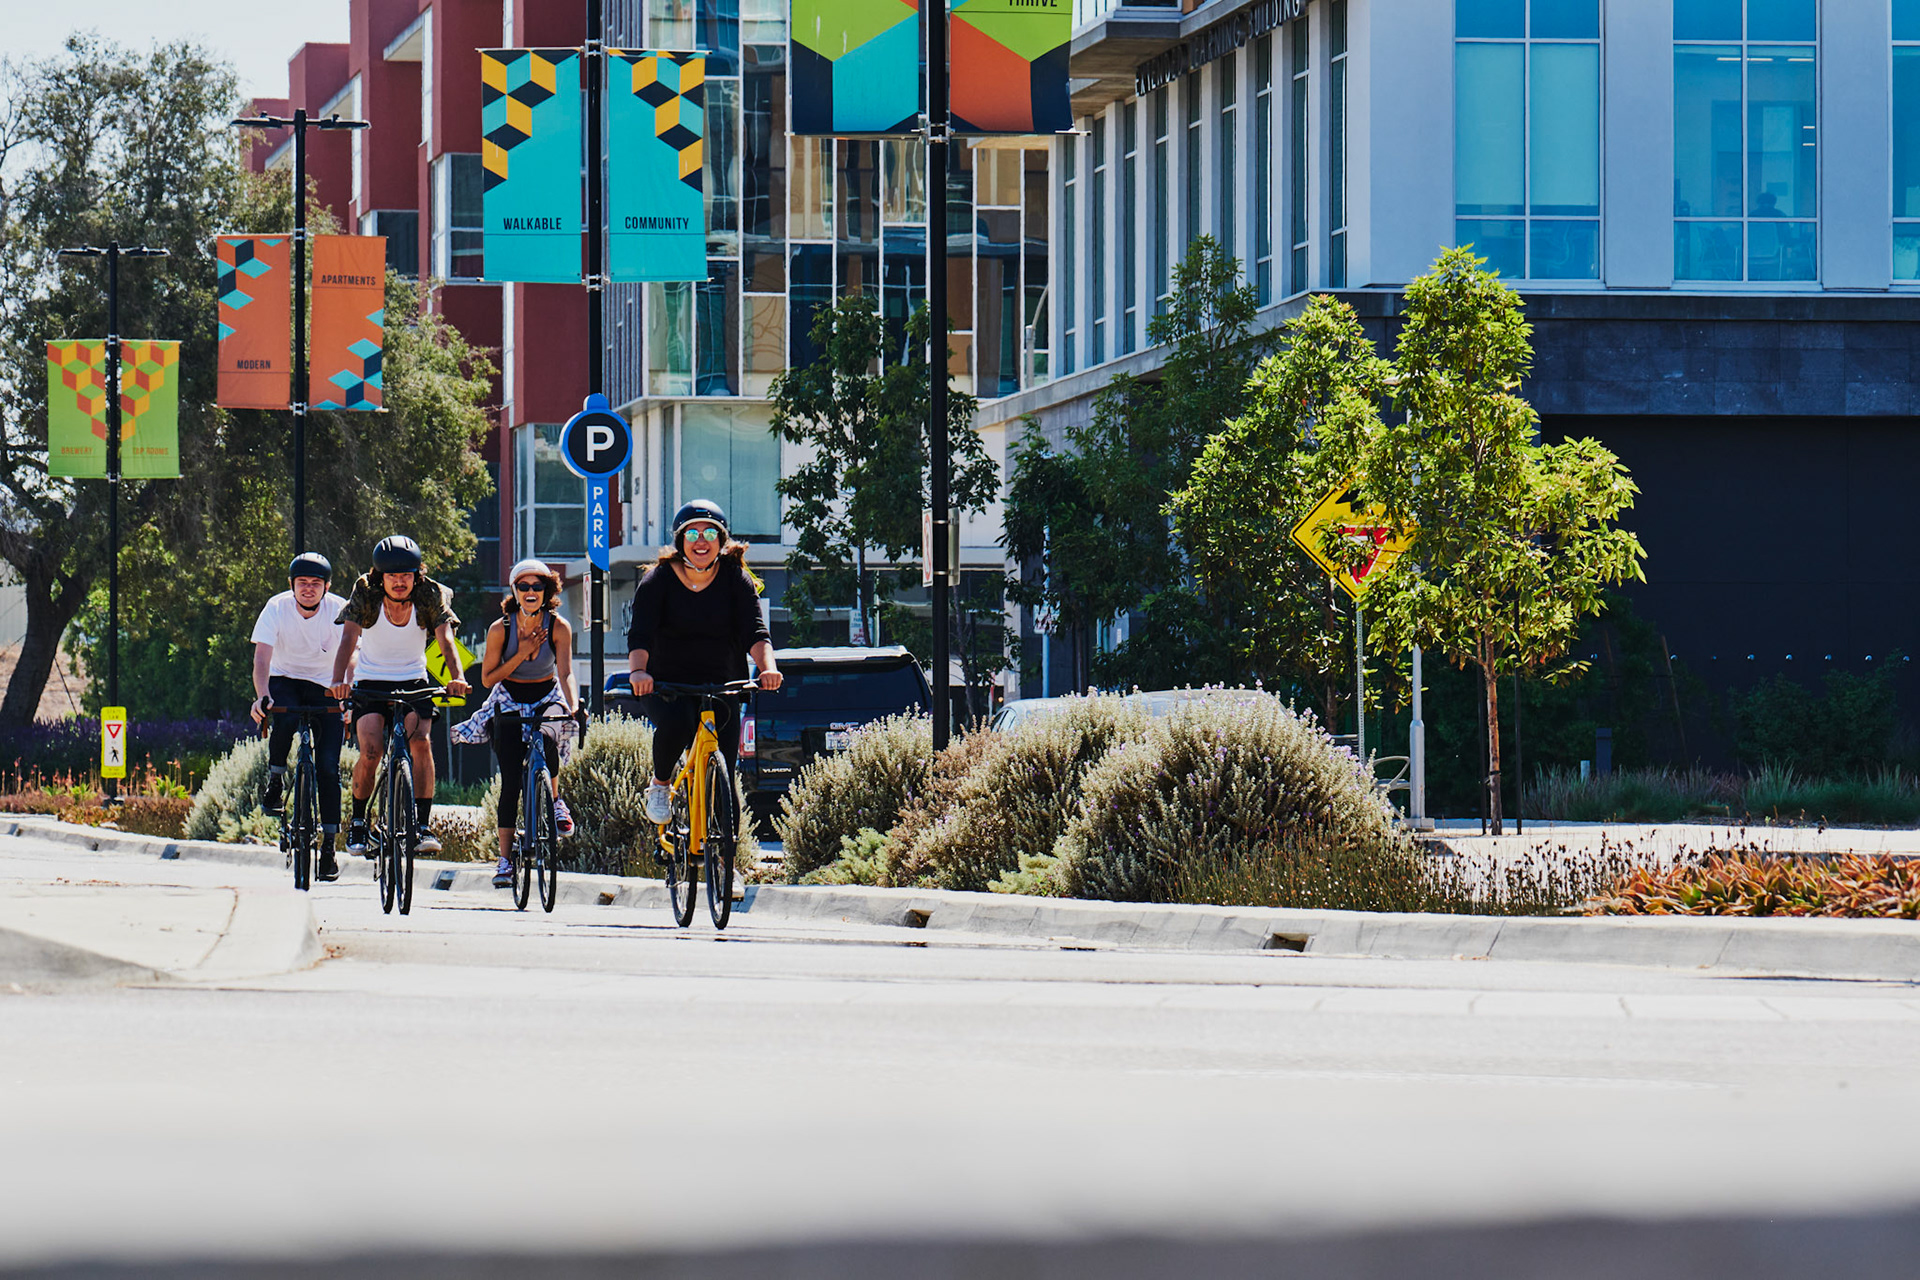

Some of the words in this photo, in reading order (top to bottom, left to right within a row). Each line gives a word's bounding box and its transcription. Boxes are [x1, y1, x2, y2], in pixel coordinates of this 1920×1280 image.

[503, 217, 562, 230] WALKABLE
[624, 216, 689, 230] COMMUNITY
[321, 274, 376, 286] APARTMENTS
[237, 359, 271, 370] MODERN
[586, 425, 615, 462] P
[592, 486, 604, 548] PARK
[830, 721, 859, 730] GMC
